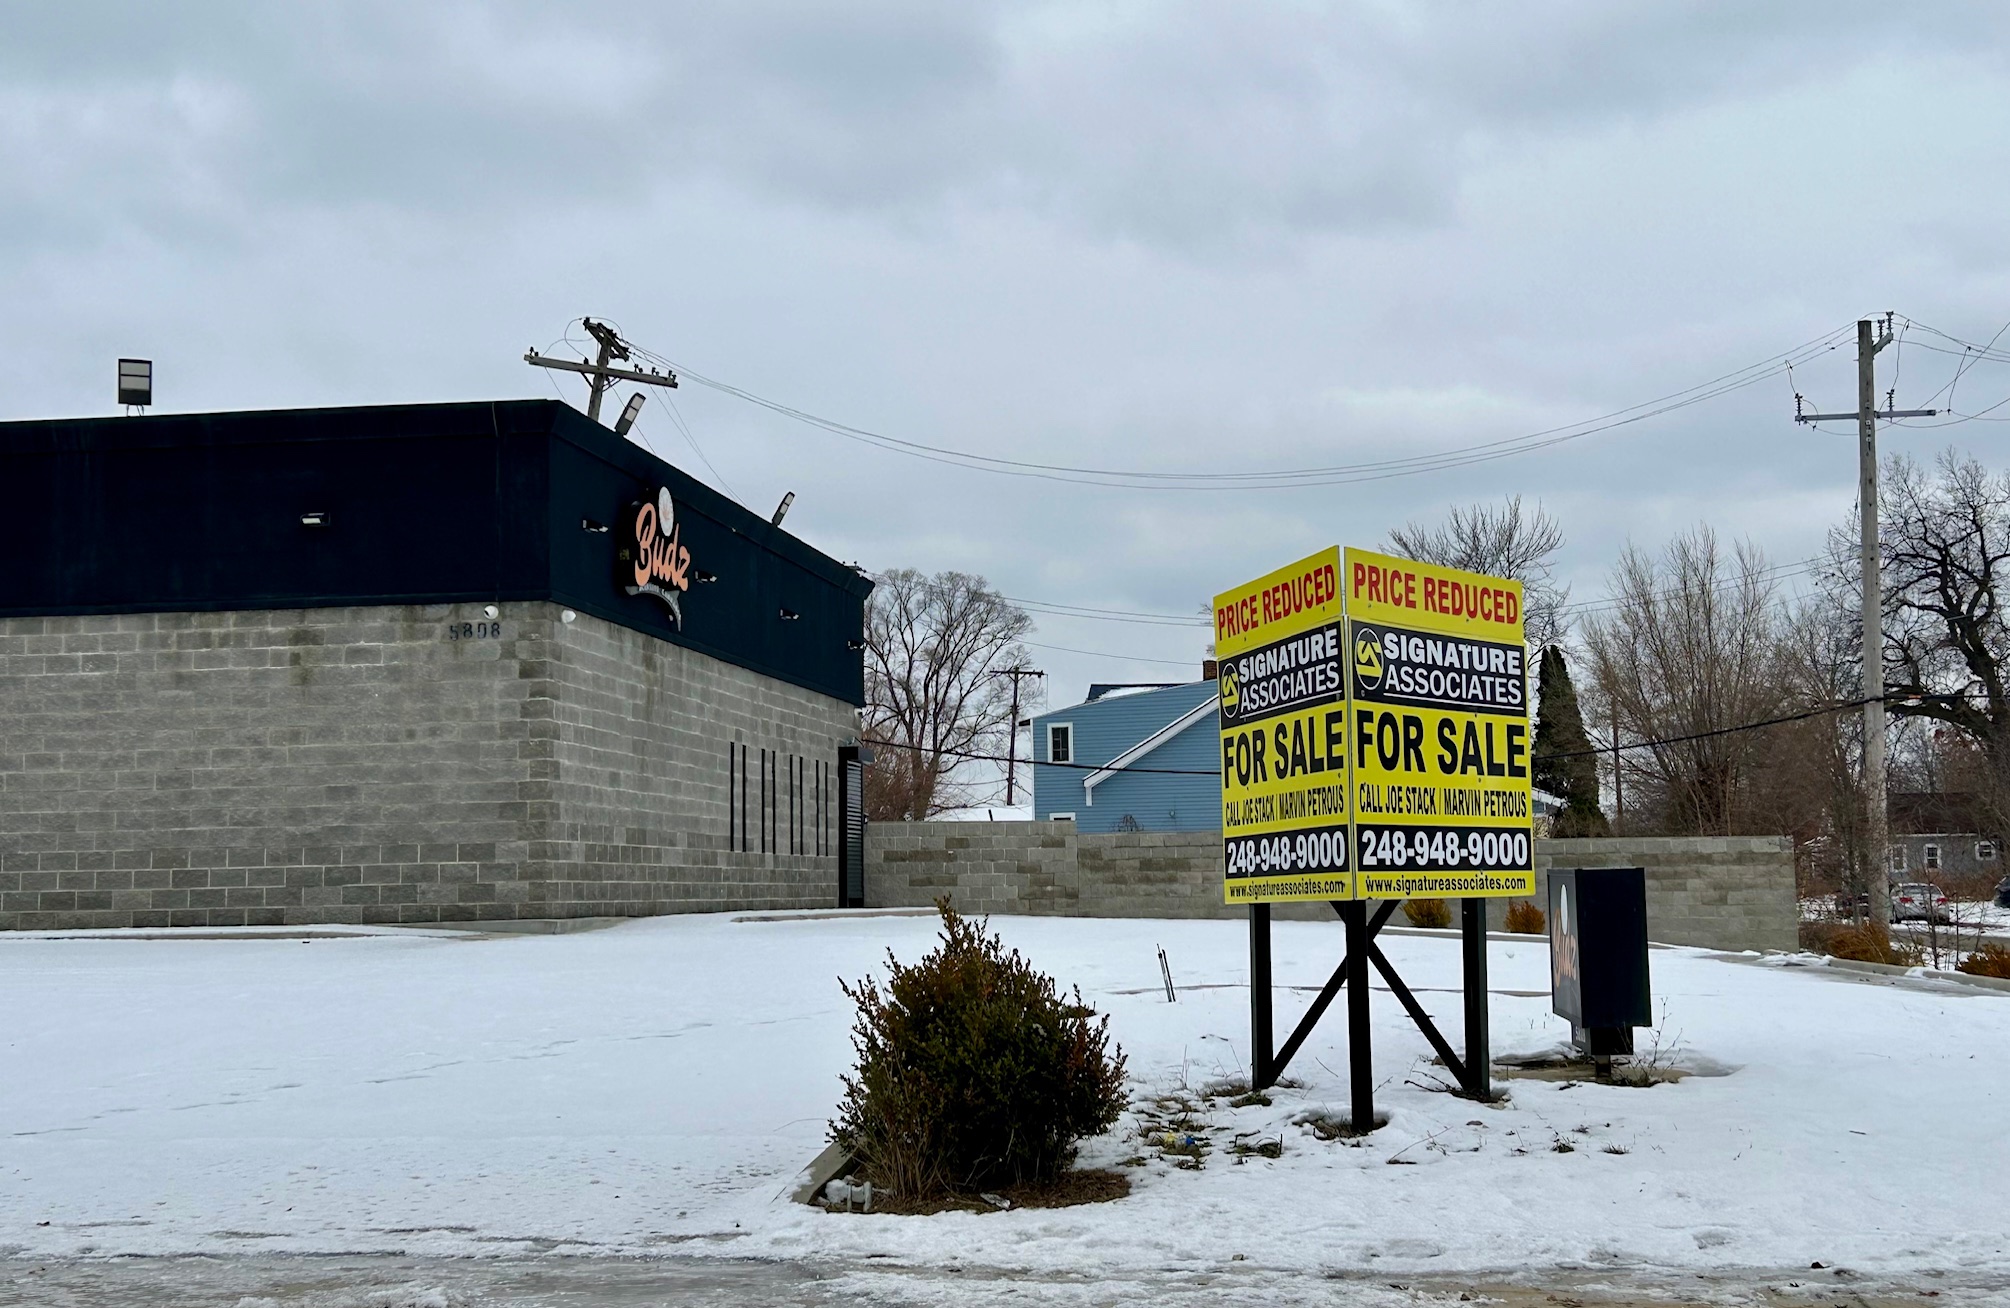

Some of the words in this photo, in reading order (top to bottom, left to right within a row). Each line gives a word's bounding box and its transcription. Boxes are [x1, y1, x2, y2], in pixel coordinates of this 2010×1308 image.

[635, 503, 690, 591] Budz
[1218, 594, 1259, 641] PRICE
[1262, 564, 1336, 621] REDUCED
[1354, 562, 1417, 609] PRICE
[1423, 576, 1518, 625] REDUCED
[450, 622, 500, 641] 5808
[1239, 629, 1339, 684] SIGNATURE
[1384, 632, 1521, 676] SIGNATURE
[1240, 661, 1339, 713] ASSOCIATES
[1385, 664, 1520, 706] ASSOCIATES
[1224, 729, 1267, 789] FOR
[1274, 711, 1344, 780] SALE
[1357, 709, 1427, 772] FOR
[1437, 718, 1526, 777] SALE
[1226, 801, 1240, 827] CALL
[1242, 798, 1253, 825] JOE
[1254, 794, 1274, 823] STACK
[1280, 789, 1305, 820] MARVIN
[1307, 784, 1344, 817] PETROUS
[1359, 783, 1383, 813] CALL
[1385, 785, 1403, 814] JOE
[1405, 785, 1436, 815] STACK
[1444, 788, 1481, 816] MARVIN
[1484, 790, 1527, 818] PETROUS
[1227, 830, 1346, 874] 248-948-9000
[1362, 830, 1528, 866] 248-948-9000
[1229, 877, 1346, 900] www.signatureassociates.com
[1365, 873, 1527, 896] www.signatureassociates.com
[1554, 908, 1576, 988] Budz
